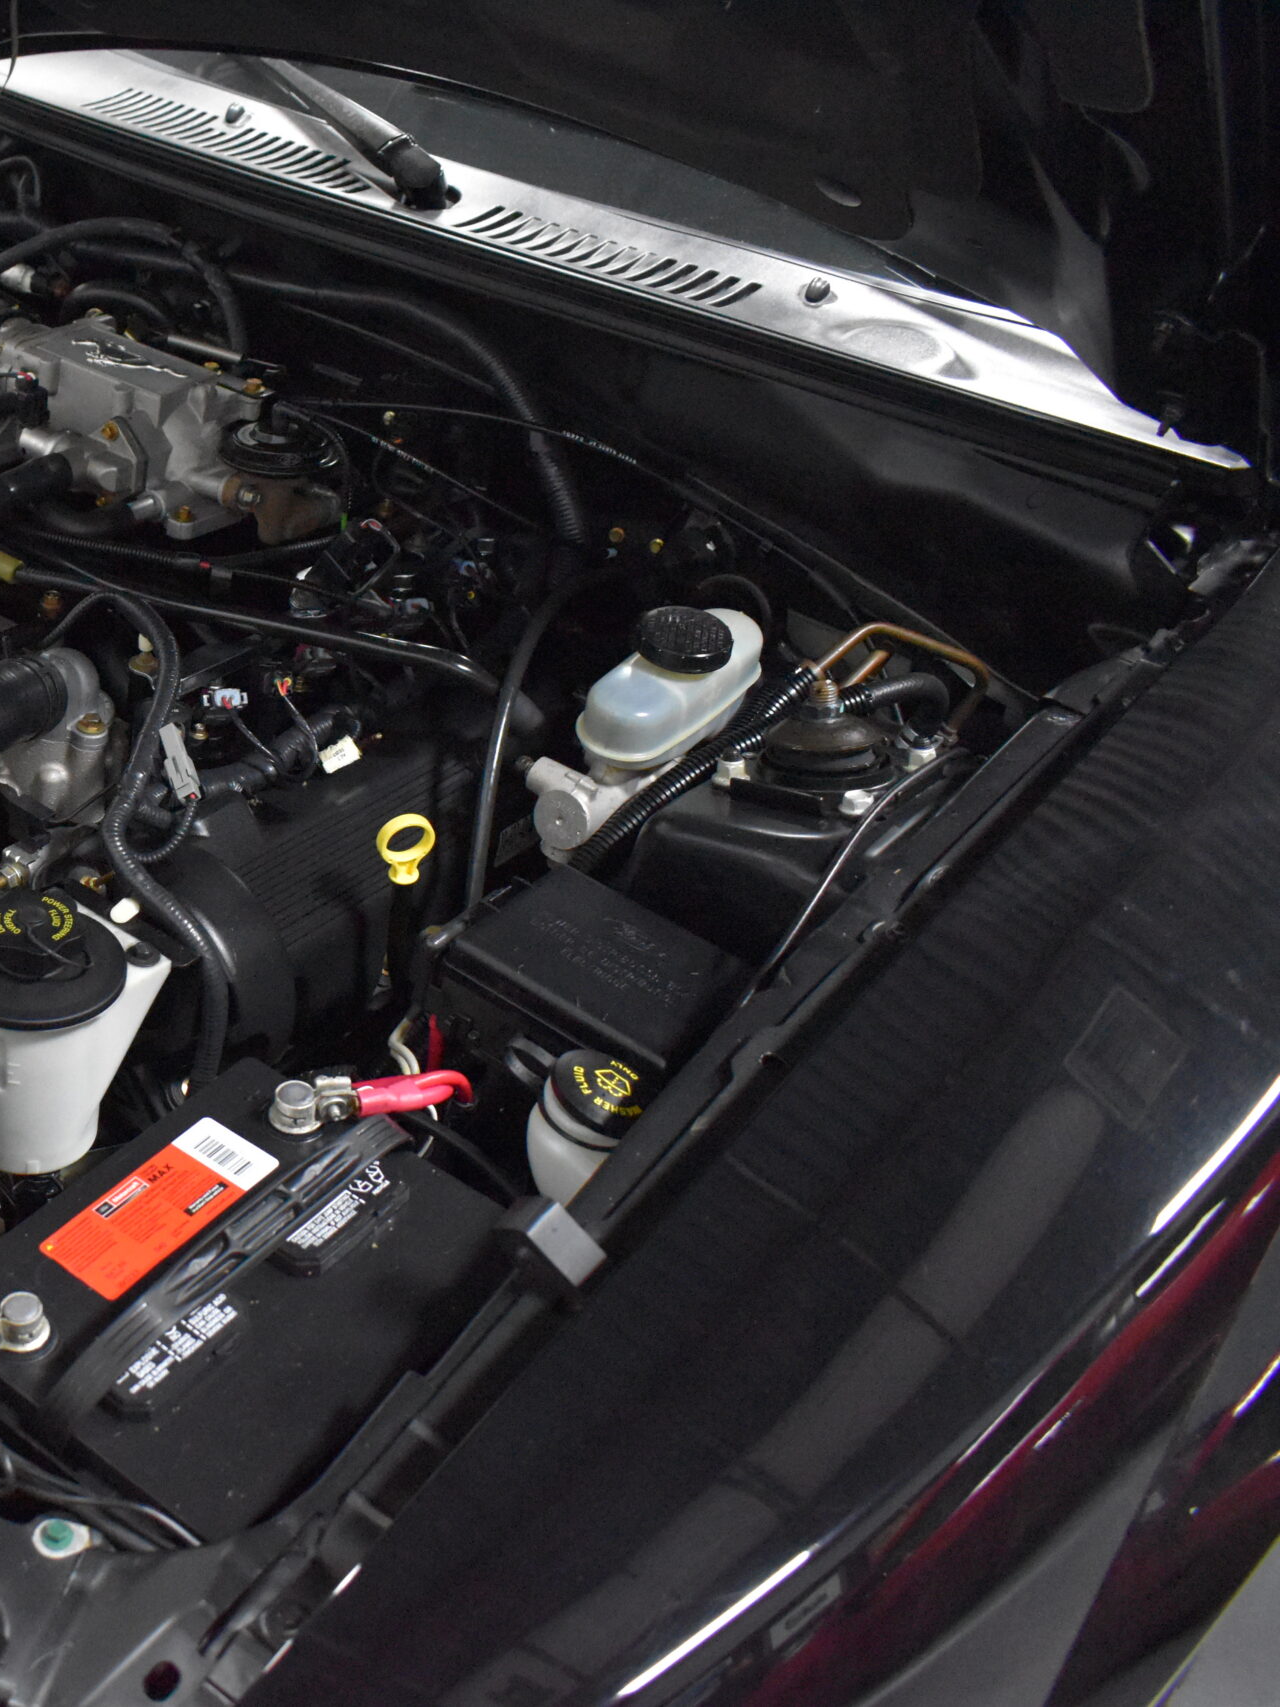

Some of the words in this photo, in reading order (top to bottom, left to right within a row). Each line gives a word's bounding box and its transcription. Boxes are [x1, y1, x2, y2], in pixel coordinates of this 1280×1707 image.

[41, 896, 70, 914] POWER
[3, 909, 22, 935] OVERFILL
[48, 909, 61, 927] FLUID
[51, 913, 74, 941] STEERING
[573, 1065, 593, 1096] FLUID
[610, 1060, 640, 1081] ONLY
[148, 1163, 174, 1183] MAX
